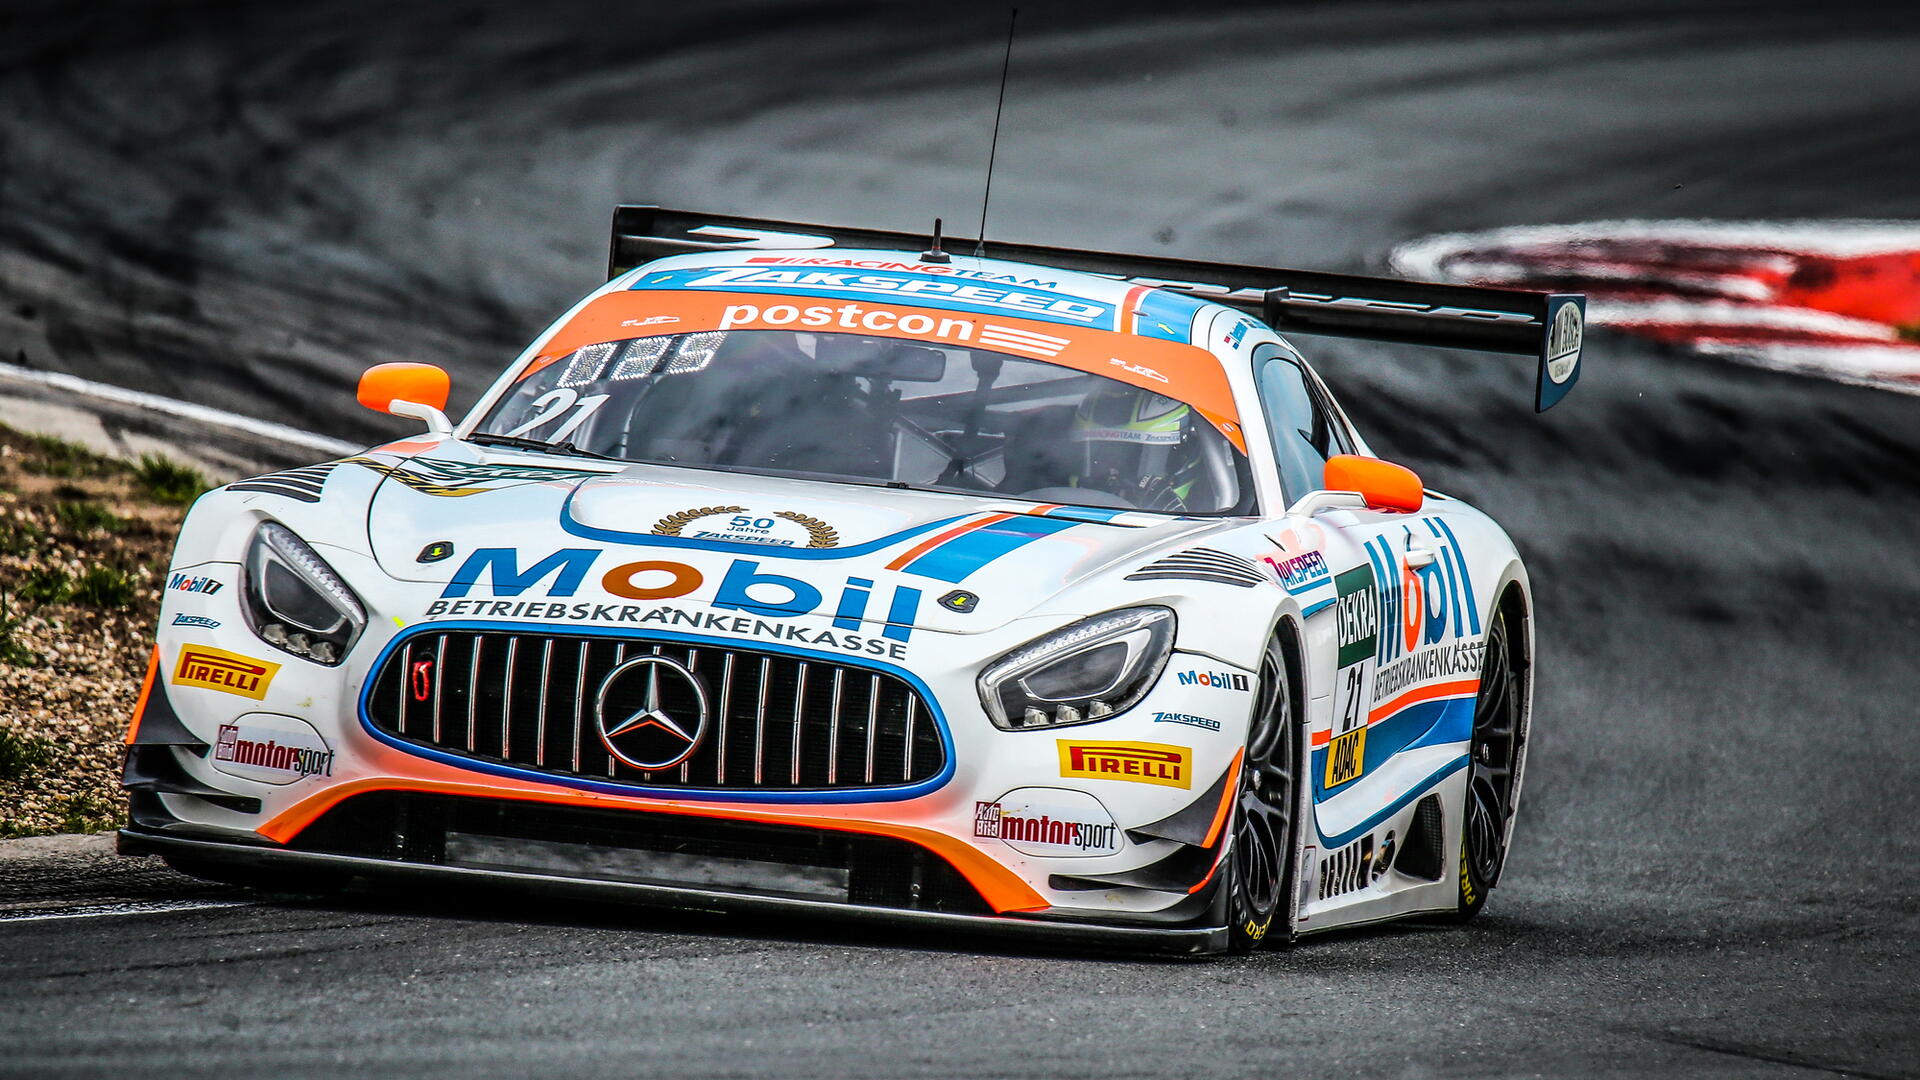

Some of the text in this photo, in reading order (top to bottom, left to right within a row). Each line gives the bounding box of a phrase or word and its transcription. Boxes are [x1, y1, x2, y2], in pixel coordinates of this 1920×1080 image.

[684, 267, 1106, 322] ZAKSPEED
[718, 304, 975, 340] postcon
[503, 388, 611, 443] 21
[692, 530, 795, 546] ZAKSPEED
[726, 525, 770, 535] Jahre
[729, 515, 775, 529] 50
[439, 547, 924, 643] Mobil
[1363, 516, 1481, 668] Mobil
[427, 600, 907, 660] BETRIEBSKRANKENKASSE
[1337, 584, 1377, 649] DEKRA
[179, 651, 267, 692] PIRELLI
[1341, 662, 1364, 733] 21
[1151, 711, 1221, 732] ZAKSPEED
[234, 739, 335, 777] motorsport
[1069, 746, 1182, 781] PIRELLI
[1331, 731, 1359, 785] ADAC
[1002, 815, 1116, 851] motorsport
